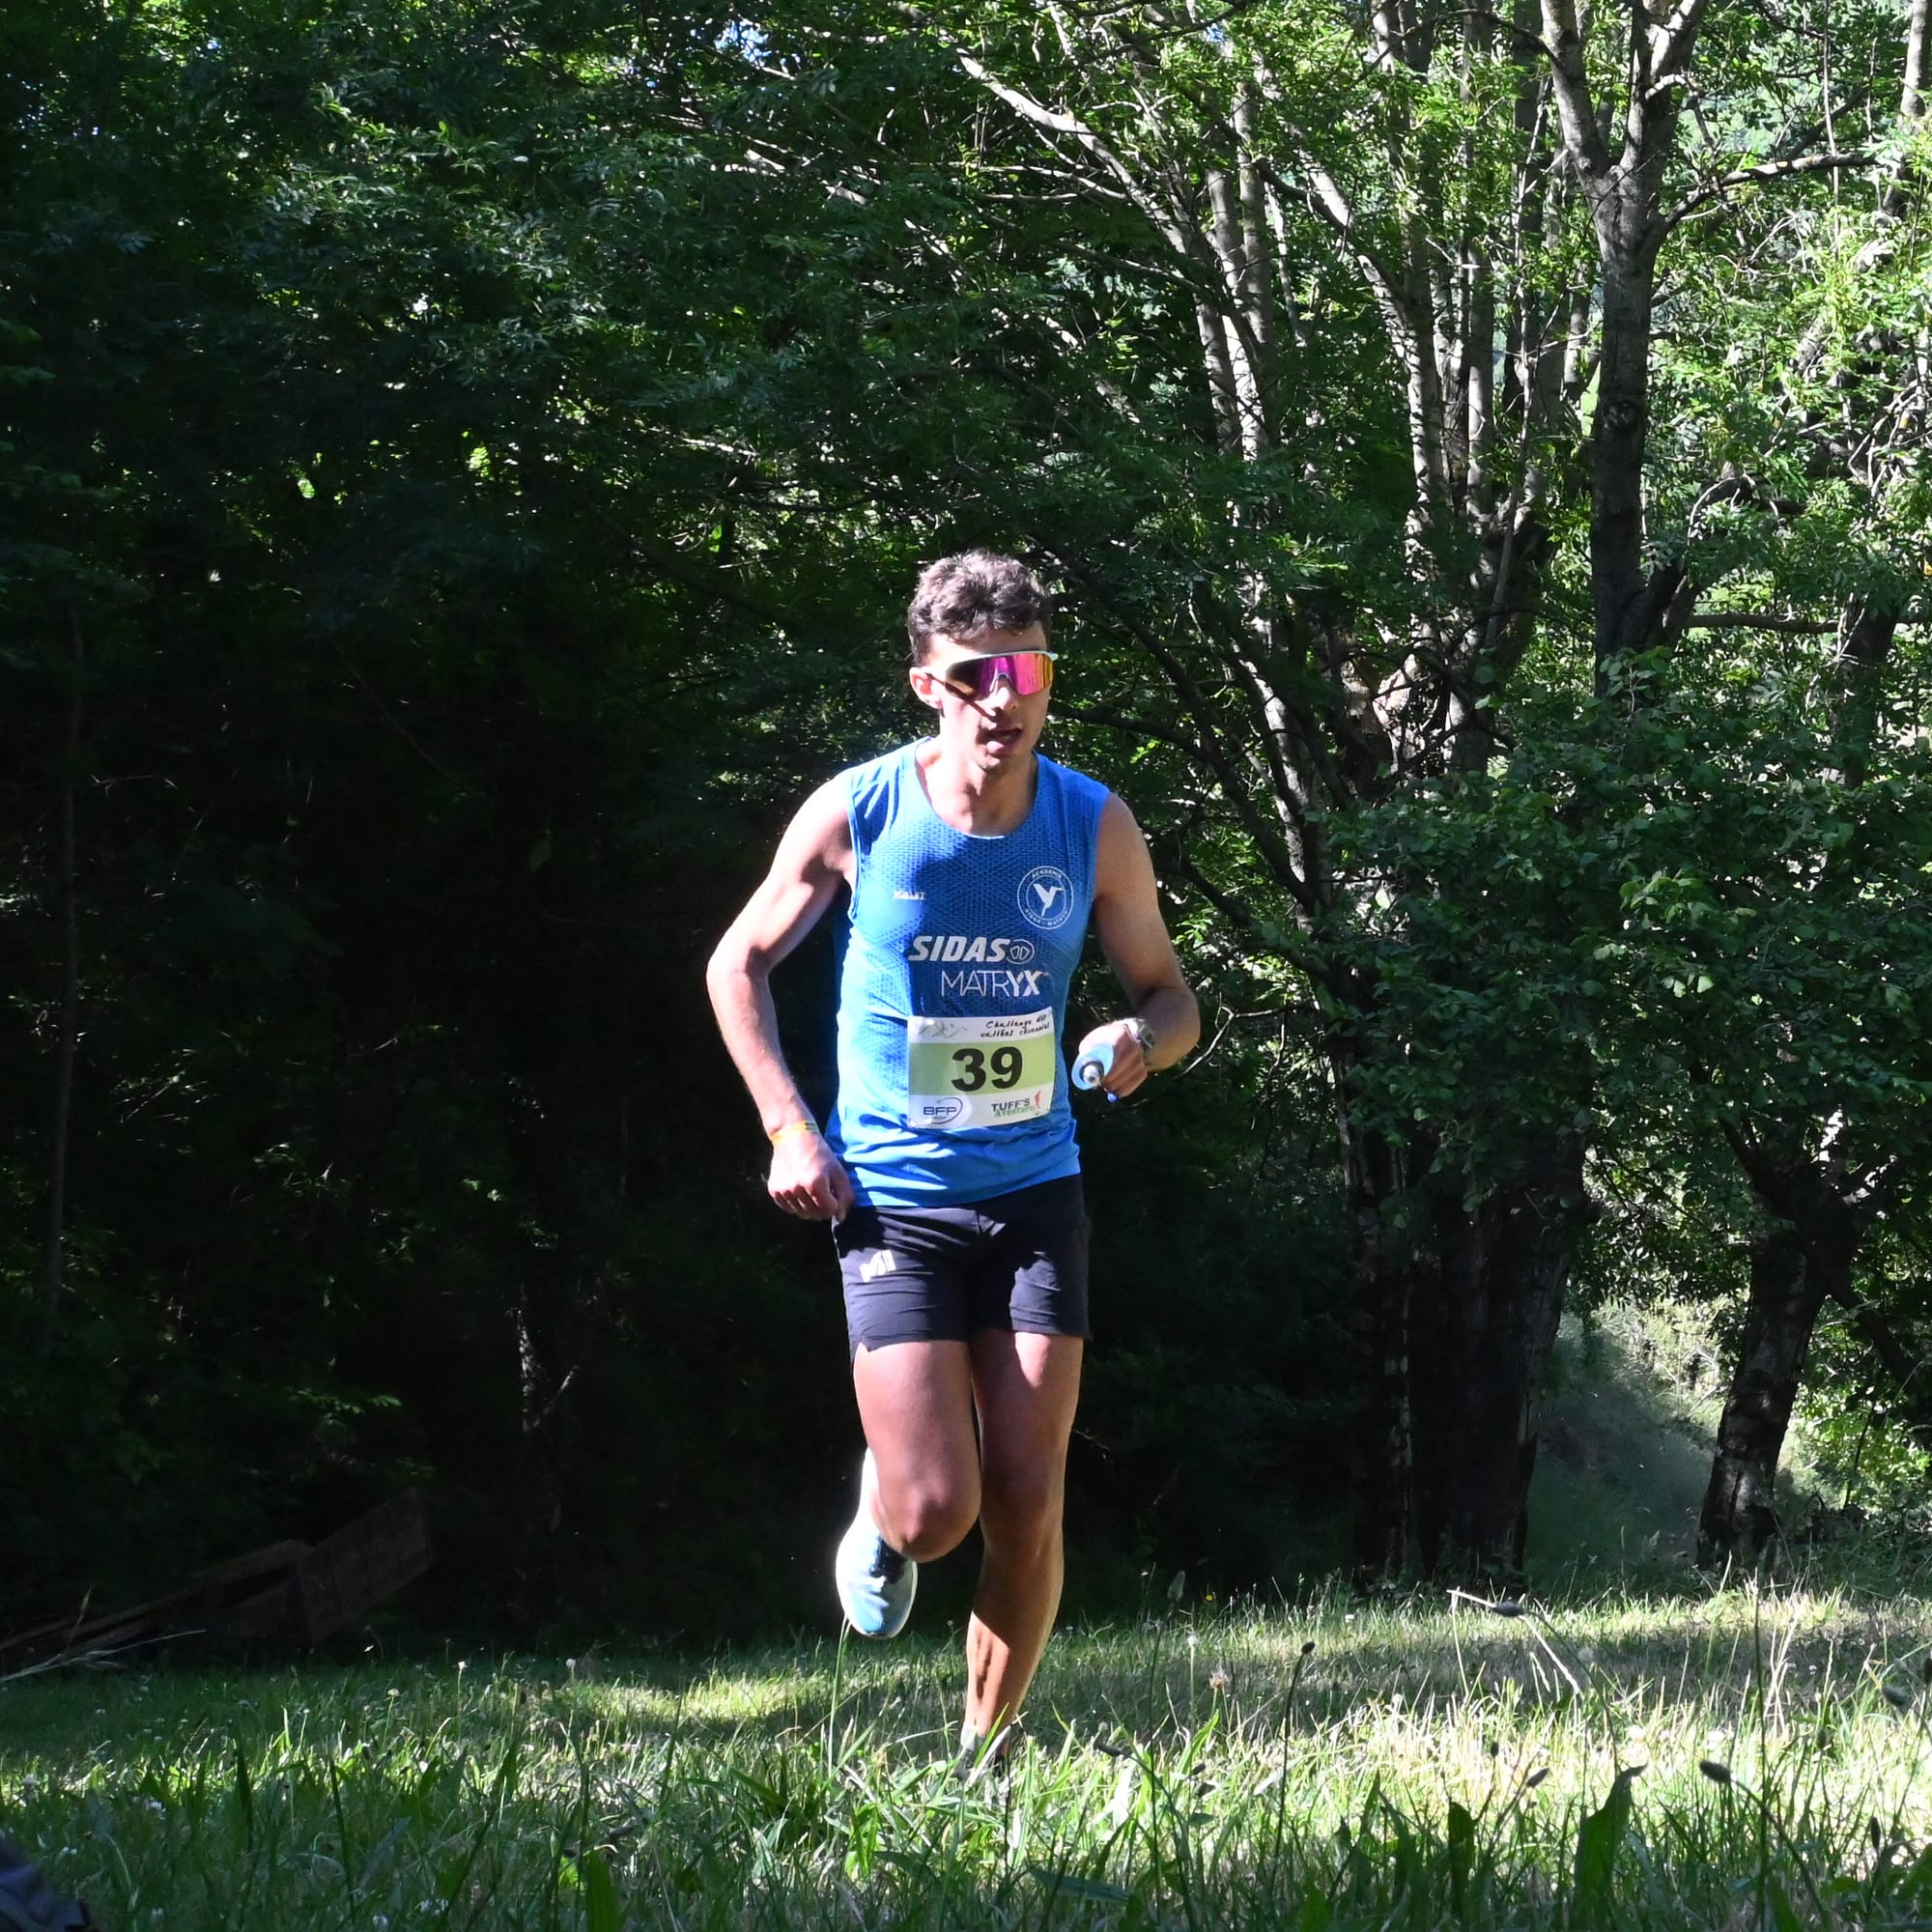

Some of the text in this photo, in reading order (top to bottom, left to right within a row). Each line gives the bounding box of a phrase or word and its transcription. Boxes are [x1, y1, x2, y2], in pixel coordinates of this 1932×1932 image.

[908, 935, 1010, 962] SIDAS
[941, 970, 1042, 998] MATRYX
[985, 1019, 1032, 1030] Challenge
[951, 1046, 1023, 1092] 39
[923, 1106, 957, 1116] BFP
[991, 1097, 1031, 1112] TUFF'S
